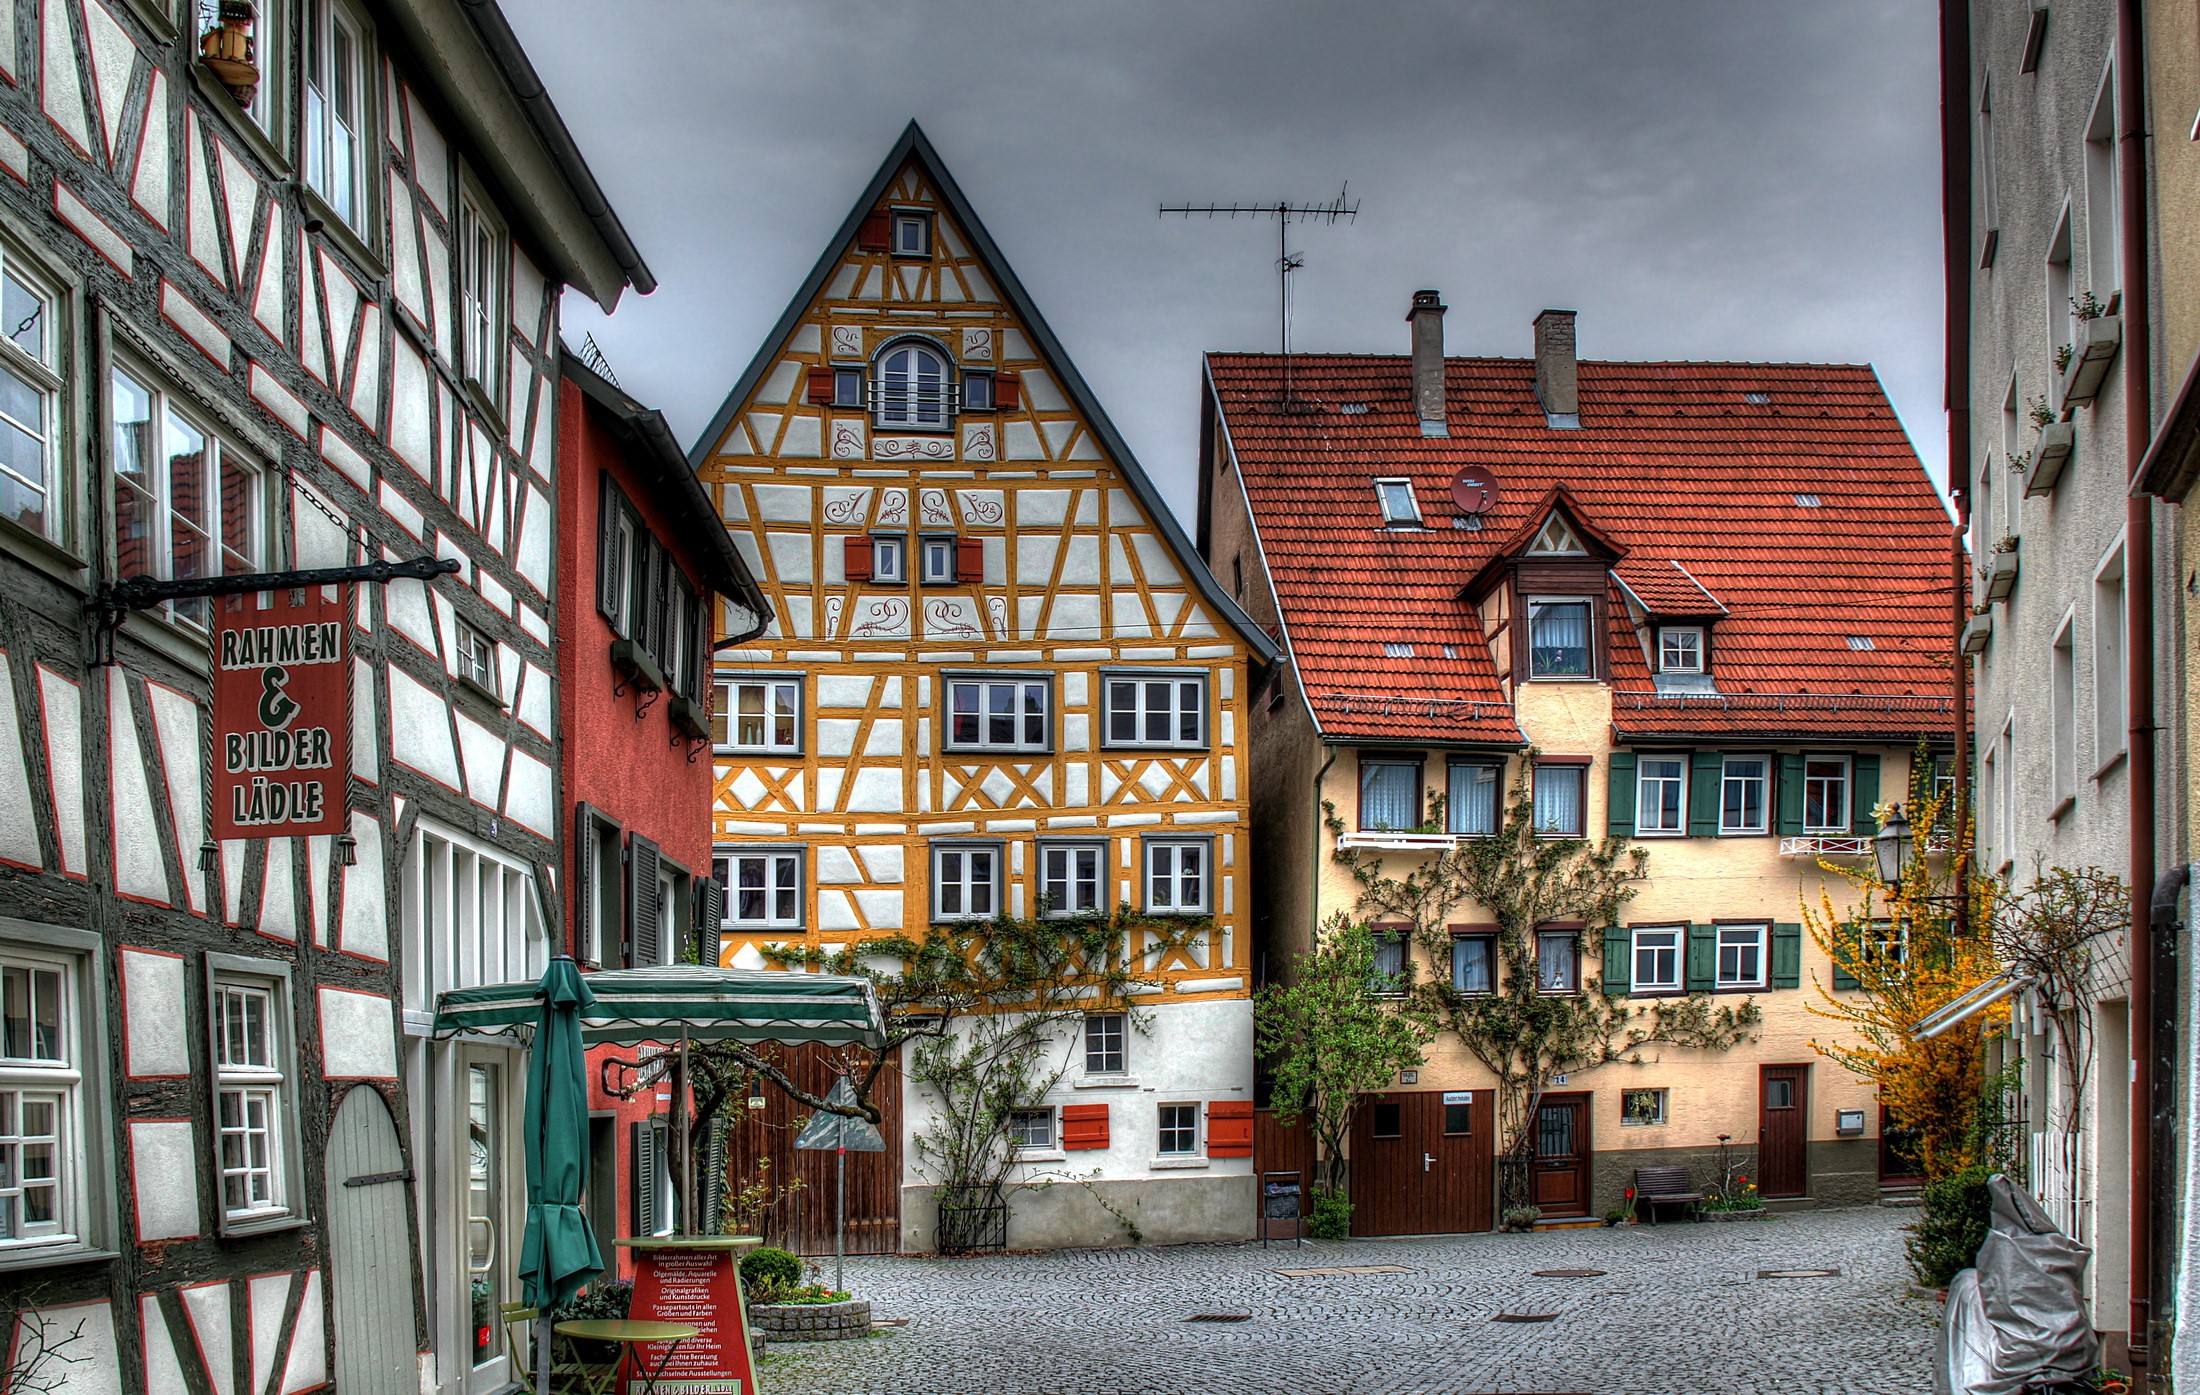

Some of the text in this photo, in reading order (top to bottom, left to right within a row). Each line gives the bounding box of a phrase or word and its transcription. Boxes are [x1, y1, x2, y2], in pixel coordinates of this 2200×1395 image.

[221, 622, 341, 671] RAHMEN
[258, 665, 301, 730] &
[226, 727, 333, 774] BILDER
[233, 777, 325, 826] LÄDLE
[1555, 1076, 1564, 1084] 14
[654, 1270, 687, 1278] Ölgemälde,
[636, 1386, 670, 1395] RAMEN
[680, 1385, 711, 1395] BILDER
